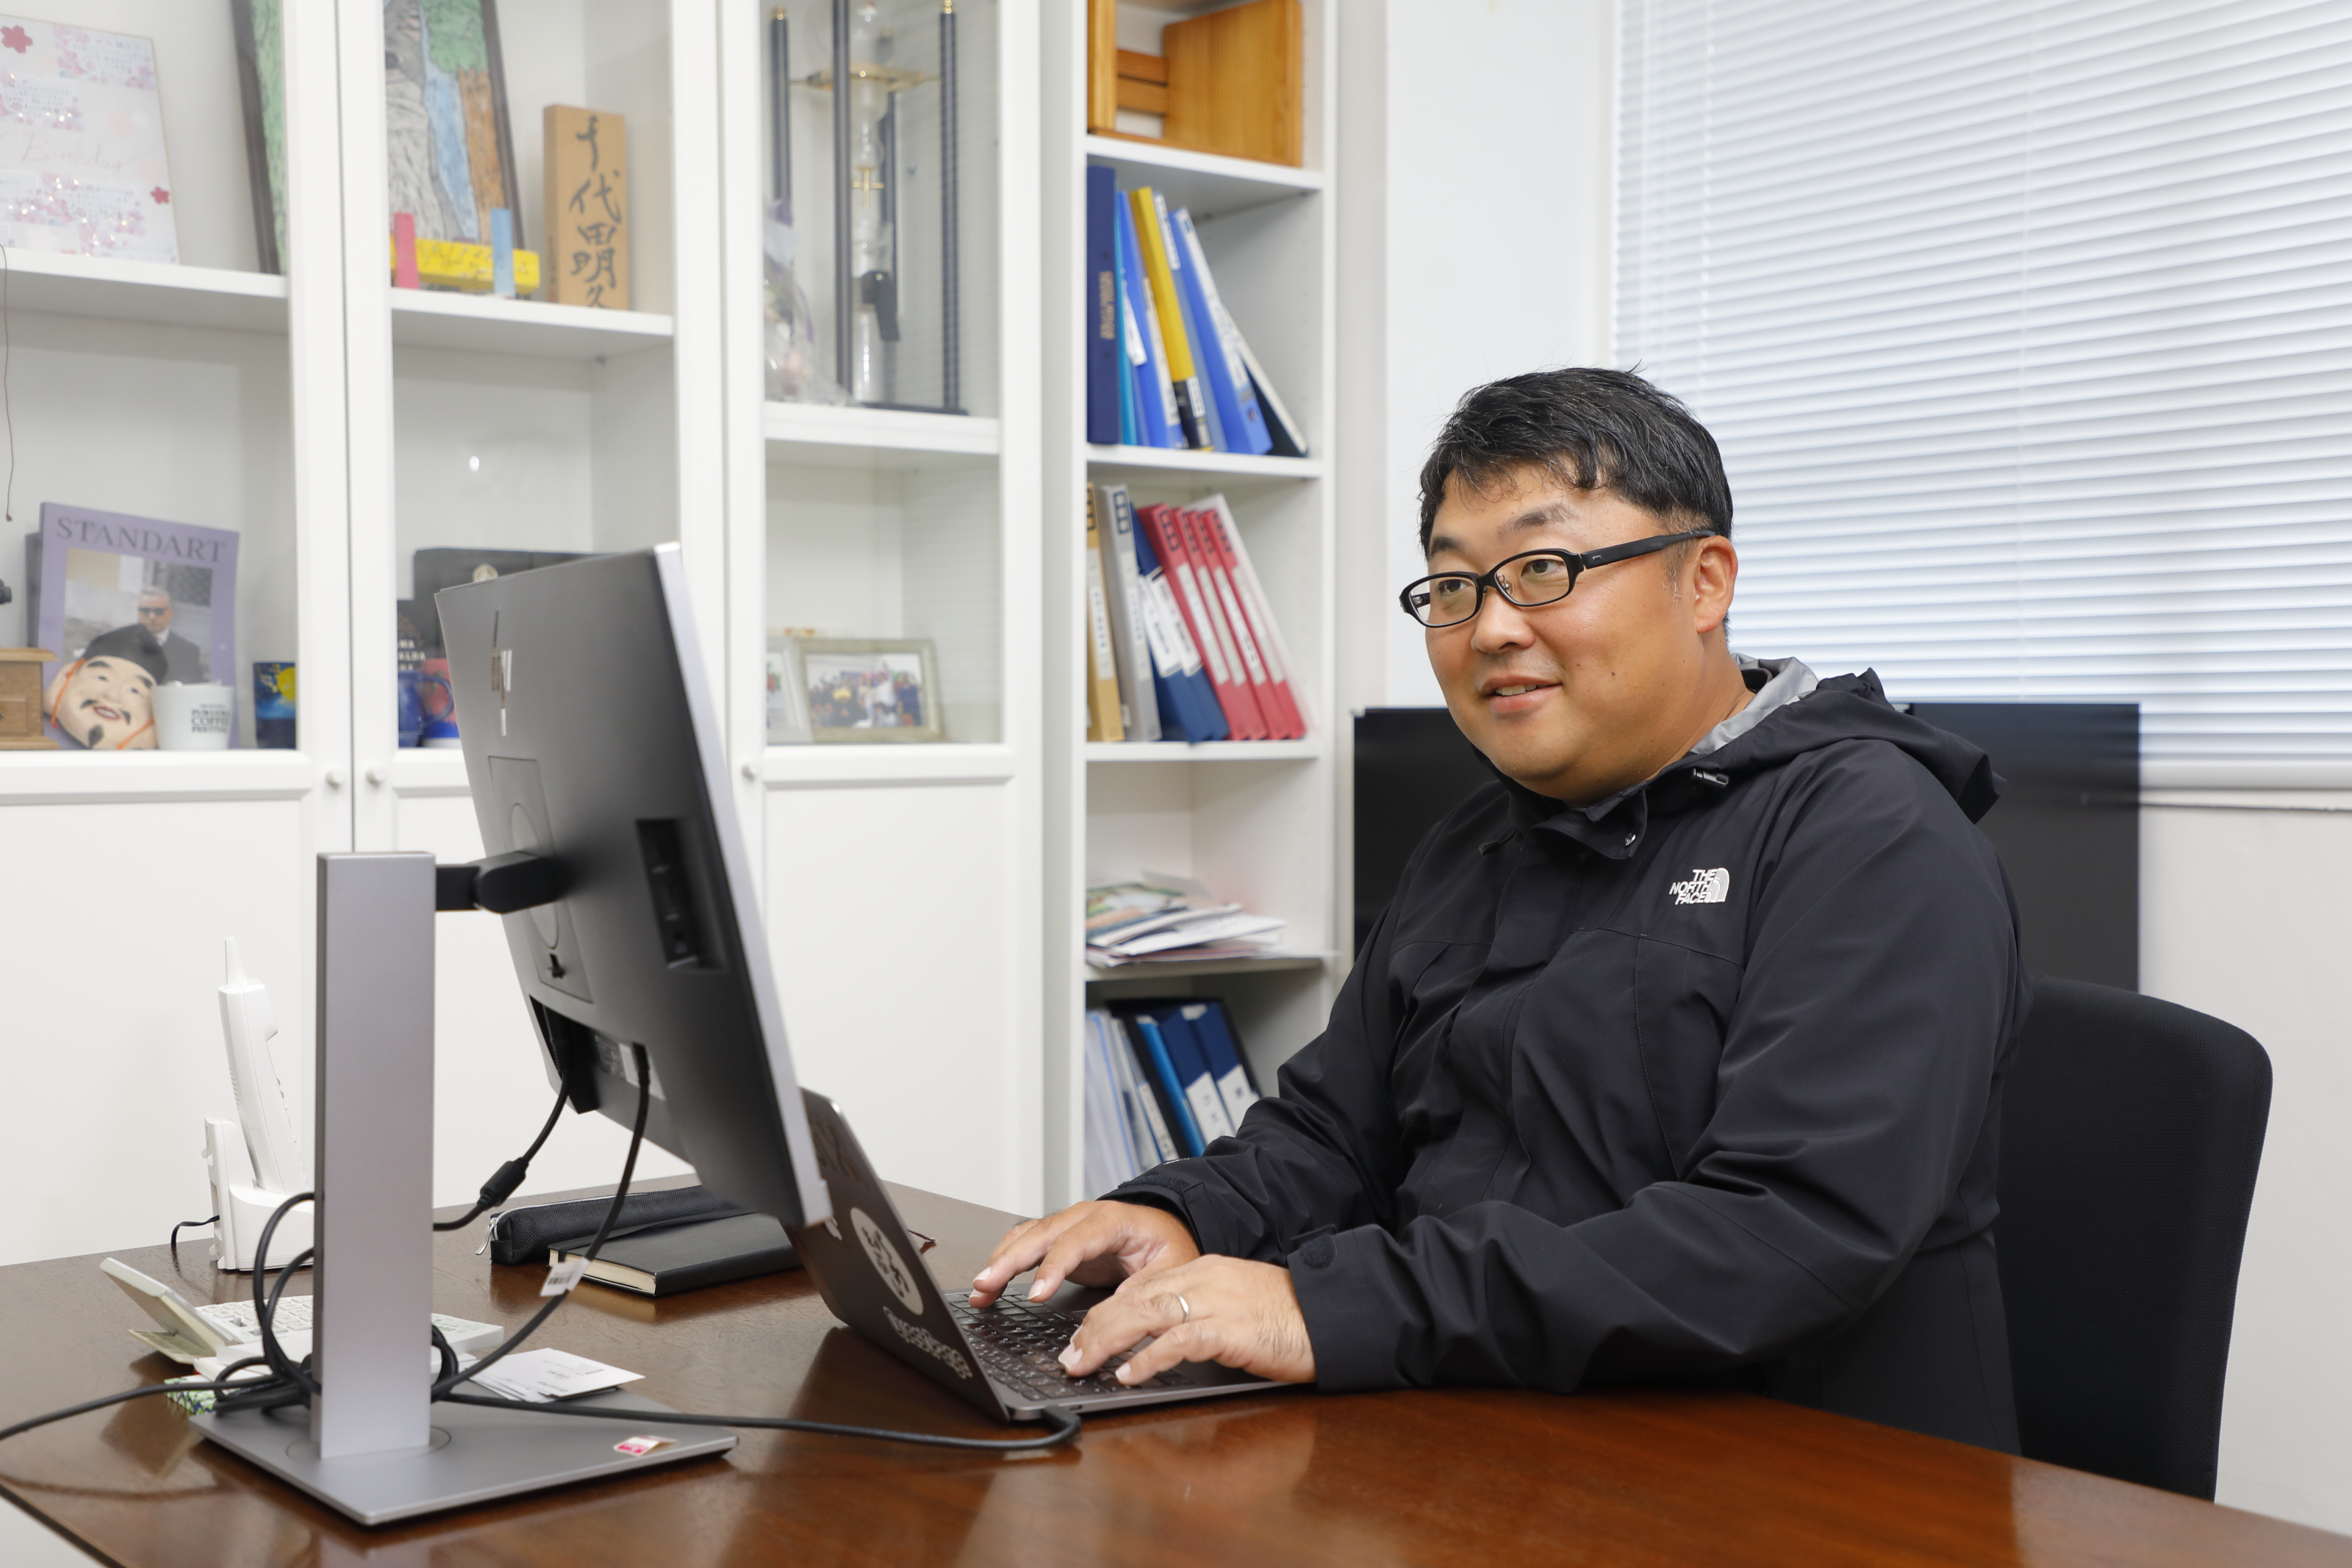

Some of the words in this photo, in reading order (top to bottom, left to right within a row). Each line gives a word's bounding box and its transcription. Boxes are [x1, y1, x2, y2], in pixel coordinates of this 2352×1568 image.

[56, 516, 227, 564] STANDART
[398, 651, 426, 661] ALDA
[1693, 869, 1718, 881] THE
[1669, 881, 1713, 894] NORTH
[1675, 893, 1706, 905] FACE
